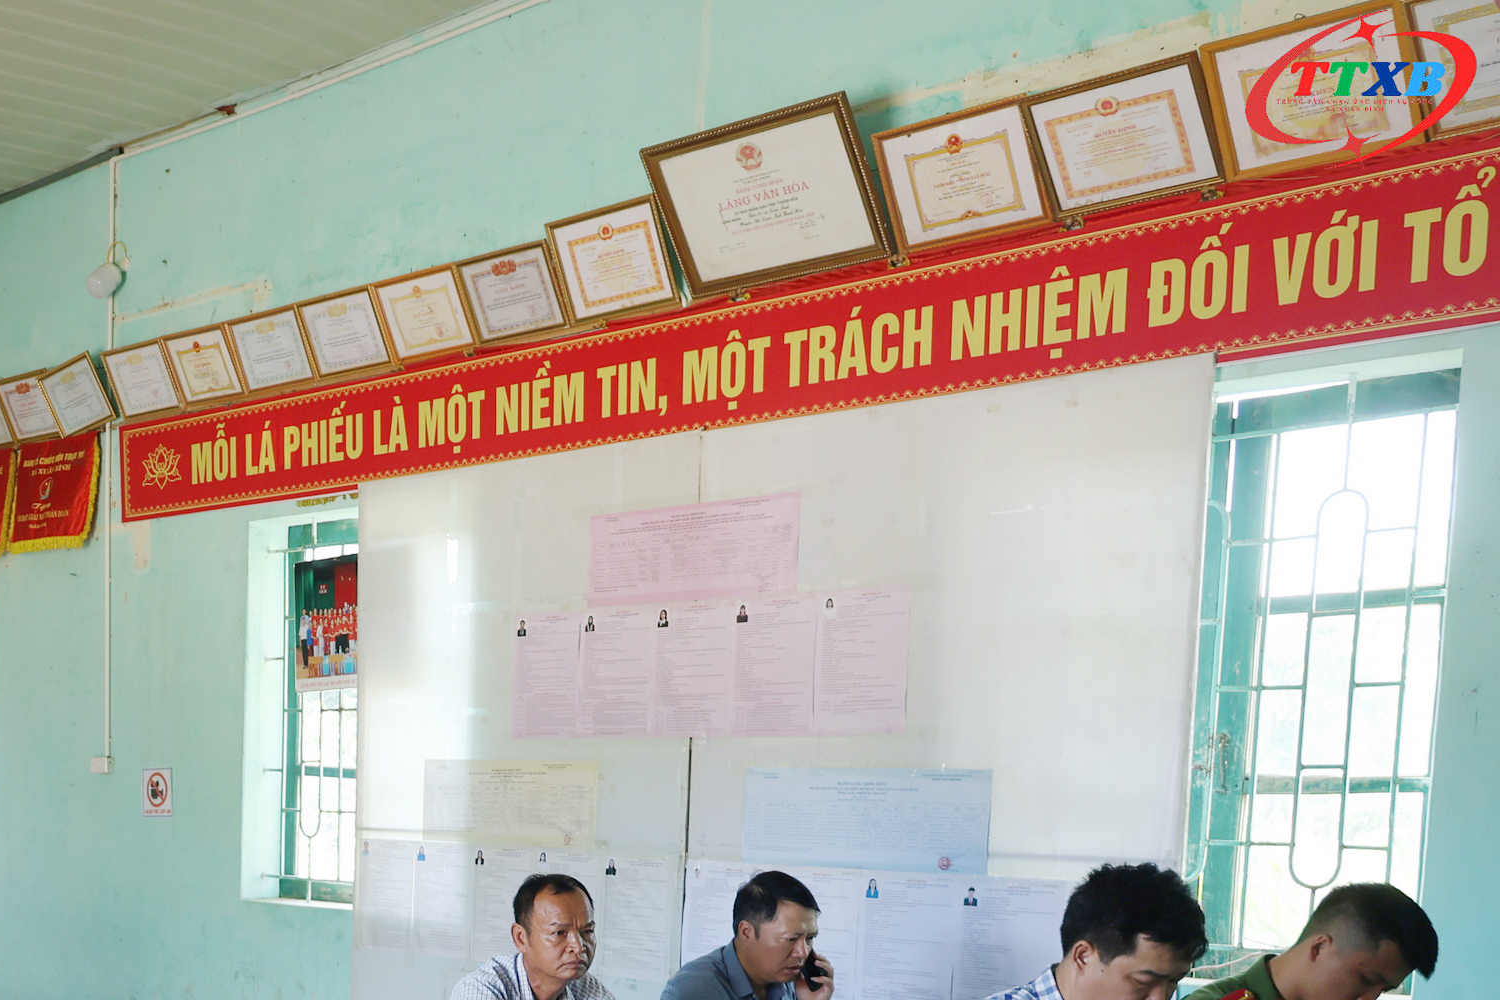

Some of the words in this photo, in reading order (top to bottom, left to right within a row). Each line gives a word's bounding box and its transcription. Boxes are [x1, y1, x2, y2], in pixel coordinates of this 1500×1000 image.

[718, 195, 751, 212] LÀNG
[753, 188, 780, 202] VĂN
[782, 181, 810, 195] HÓA
[751, 182, 768, 190] CÔNG
[190, 418, 237, 485] MỖI
[245, 420, 276, 477] LÁ
[284, 404, 363, 470] PHIẾU
[372, 395, 408, 456] LÀ
[419, 383, 485, 452] MỘT
[496, 359, 586, 436] NIỀM
[597, 357, 669, 419] TIN,
[683, 328, 771, 408] MỘT
[784, 305, 934, 388] TRÁCH
[950, 266, 1128, 361] NHIỆM
[1146, 235, 1250, 328] ĐỐI
[1271, 215, 1379, 306] VỚI
[1403, 165, 1497, 284] TỔ
